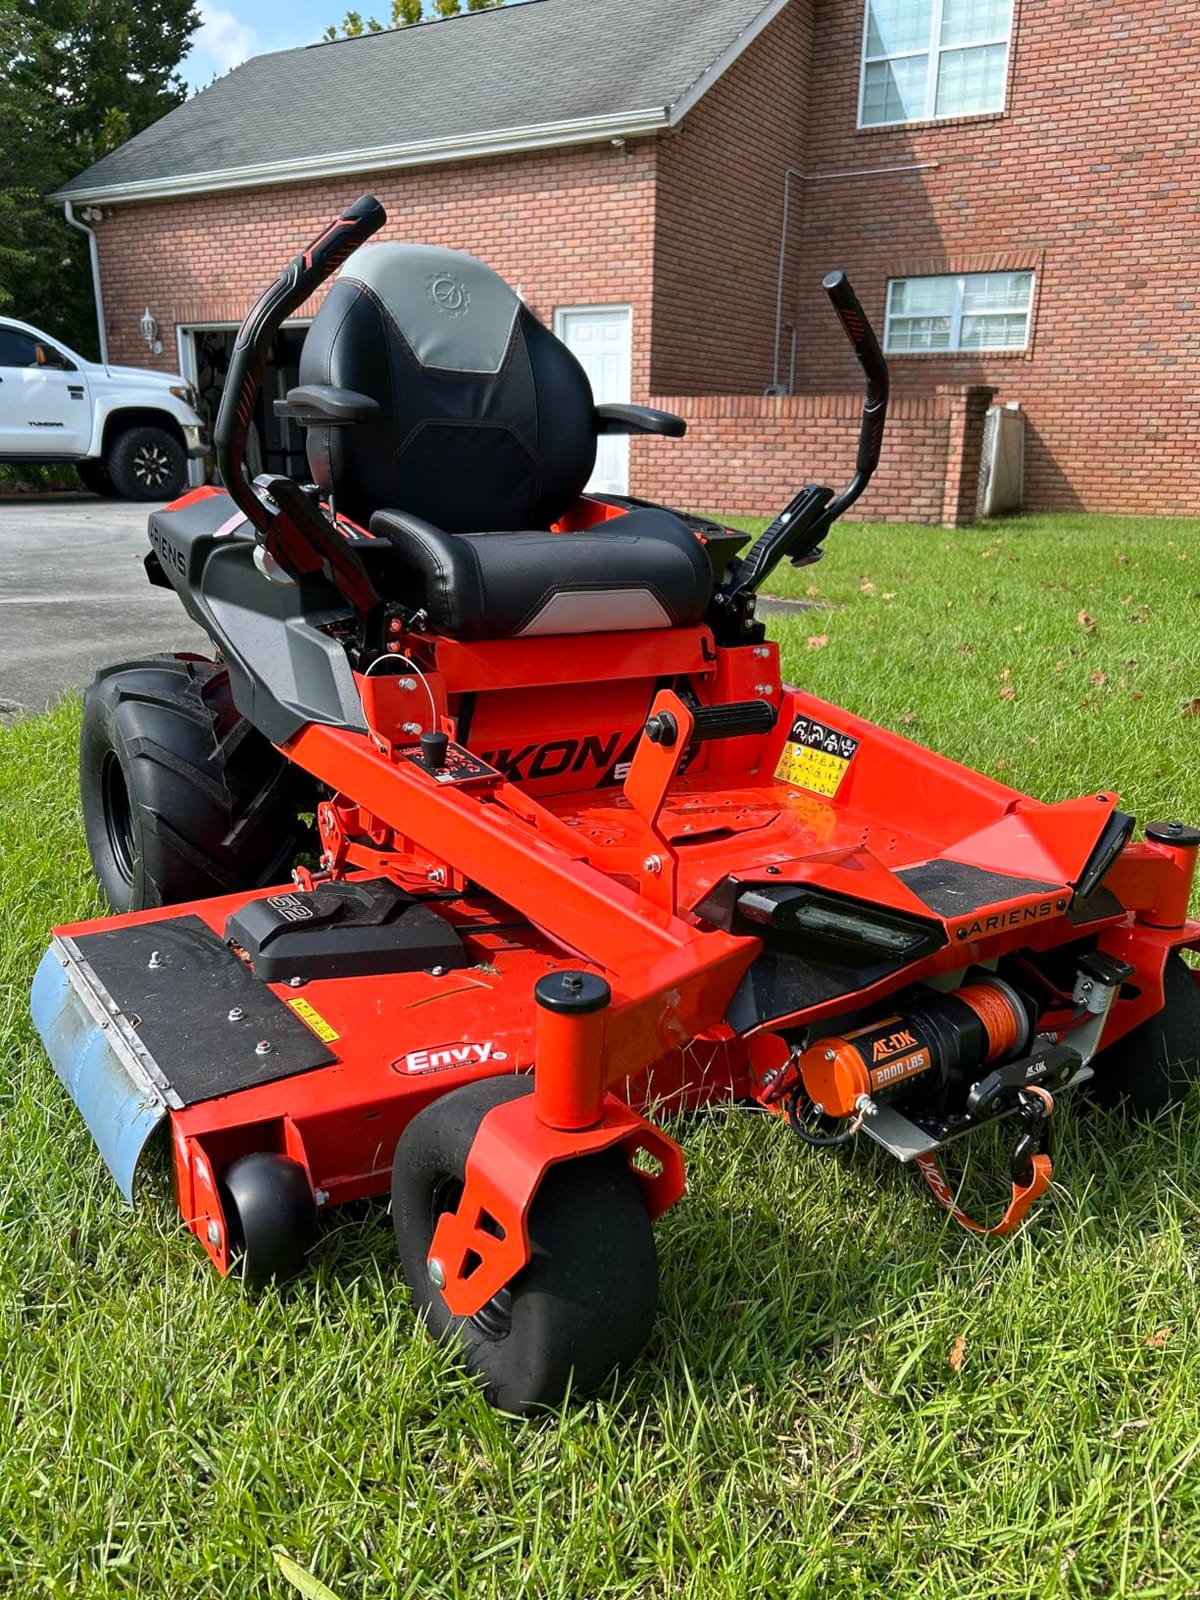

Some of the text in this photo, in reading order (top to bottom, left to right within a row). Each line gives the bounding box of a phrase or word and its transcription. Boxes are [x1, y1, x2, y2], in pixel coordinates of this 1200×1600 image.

[266, 893, 313, 921] 52
[967, 902, 1052, 936] ARIENS
[406, 1041, 493, 1072] Envy
[873, 1029, 919, 1062] AC-DK
[876, 1053, 925, 1083] 2000 LBS
